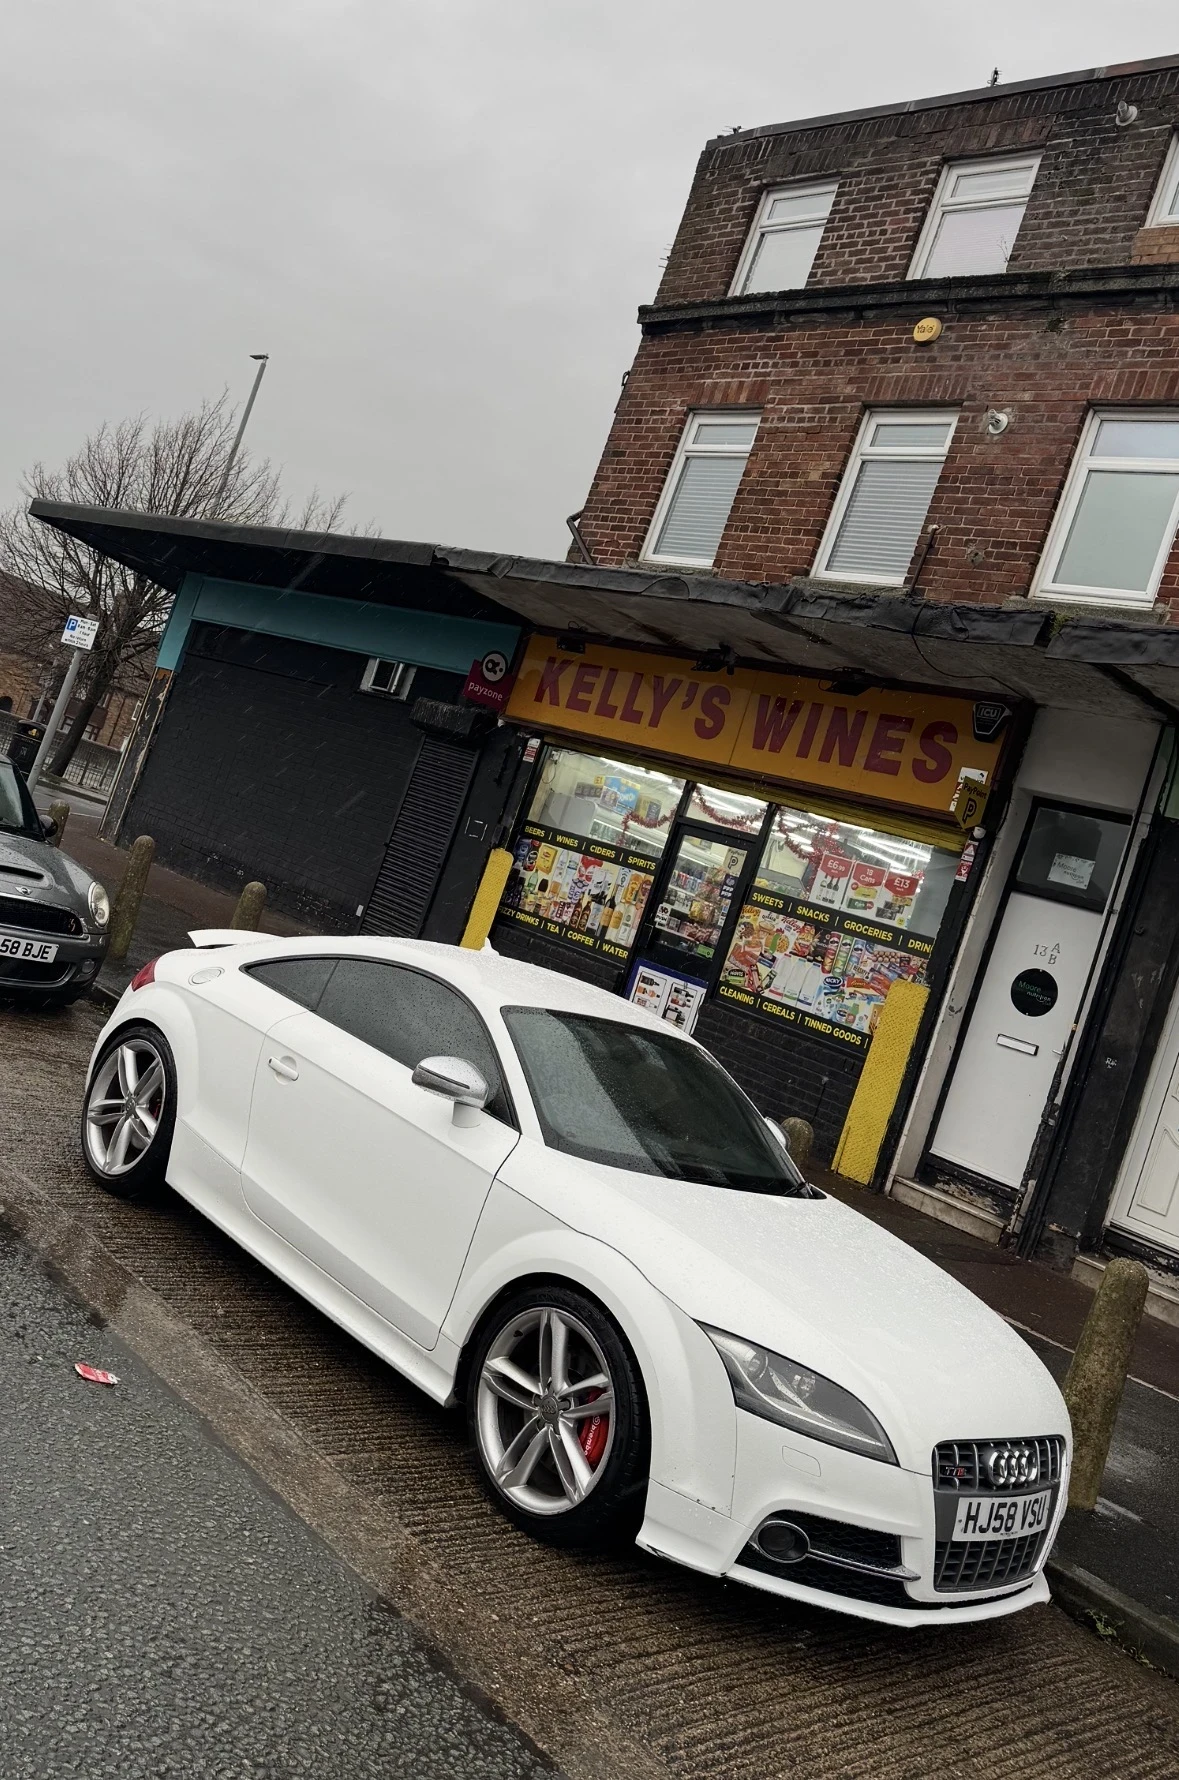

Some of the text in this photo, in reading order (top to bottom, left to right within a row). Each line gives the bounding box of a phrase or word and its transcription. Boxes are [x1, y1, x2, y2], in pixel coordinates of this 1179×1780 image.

[467, 682, 503, 701] payzone
[533, 656, 731, 740] KELLY'S
[980, 707, 998, 718] ICU
[752, 694, 959, 783] WINES
[963, 782, 987, 799] PayPoint
[524, 825, 657, 870] BEERS WINES CIDERS SPIRITS
[860, 875, 876, 884] Cans
[893, 877, 910, 889] £13
[515, 911, 540, 926] DRINKS
[752, 892, 934, 953] SWEETS SNACKS GROCERIES DRIN
[0, 939, 52, 960] 58 BJE
[546, 922, 629, 959] TEA COFFEE WATER
[1051, 942, 1060, 954] A
[1033, 944, 1049, 957] 13
[1047, 953, 1057, 965] B
[1018, 980, 1042, 993] Moore
[719, 986, 862, 1046] CLEANING CEREALS TINNED GOODS
[963, 1494, 1048, 1534] HJ58 VSU
